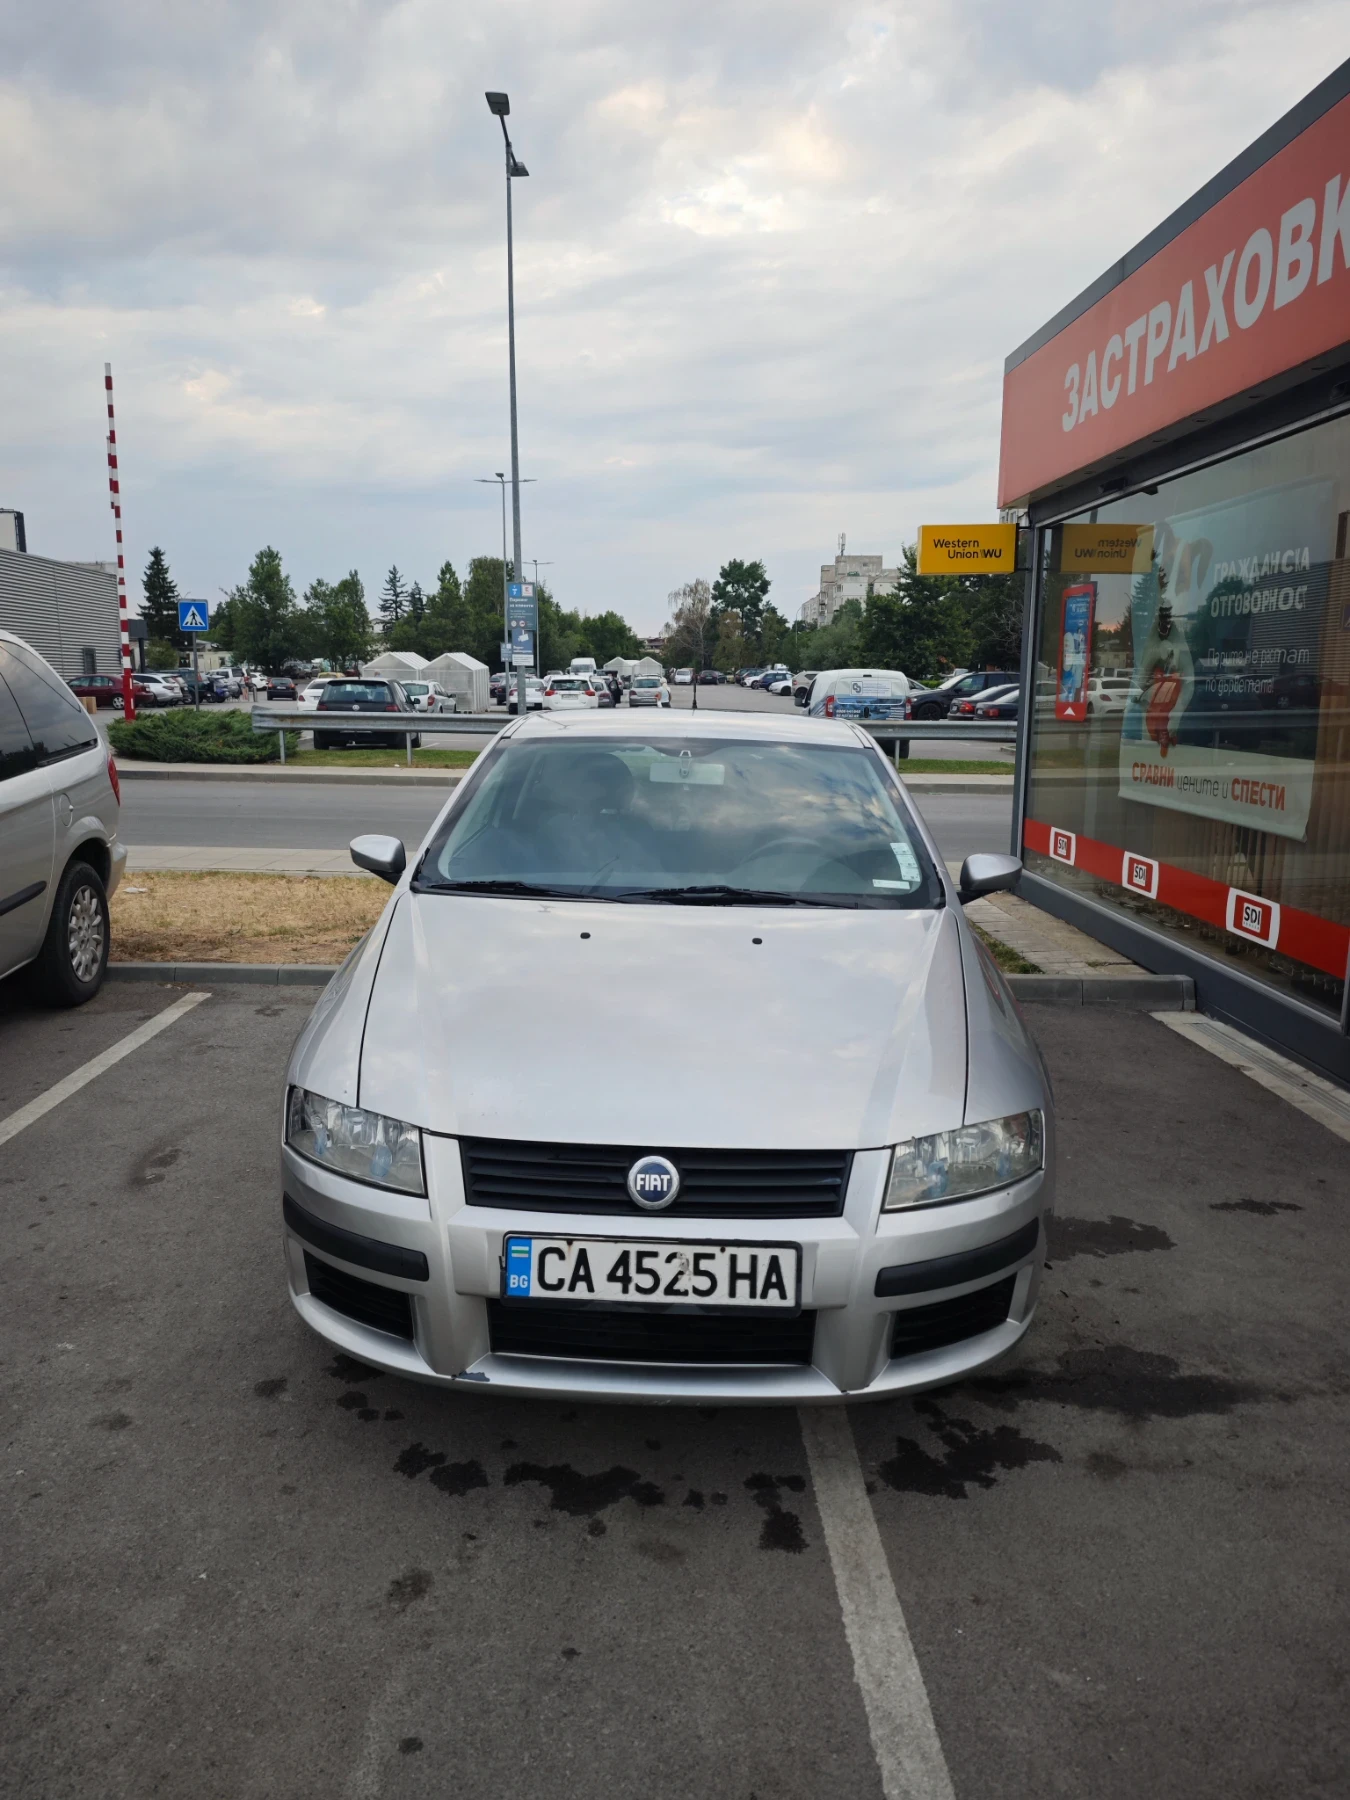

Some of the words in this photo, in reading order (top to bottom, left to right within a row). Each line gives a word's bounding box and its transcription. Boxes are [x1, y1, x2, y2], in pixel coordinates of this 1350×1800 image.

[933, 538, 979, 549] Western
[948, 548, 979, 559] Union
[983, 549, 1002, 558] WU
[1213, 546, 1310, 585] ГРАЖДАНСКА
[1207, 648, 1244, 668] Парите
[1245, 648, 1258, 664] не
[1132, 762, 1174, 788] СРАВНИ
[1176, 775, 1219, 795] цените
[1222, 782, 1229, 799] и
[1231, 777, 1286, 811] СПЕСТИ
[1134, 865, 1146, 881] SDI
[1244, 906, 1261, 925] SDI
[636, 1173, 671, 1191] FIAT
[509, 1274, 529, 1289] BG
[537, 1246, 595, 1294] CA
[606, 1249, 718, 1297] 4525
[728, 1253, 788, 1300] HA
